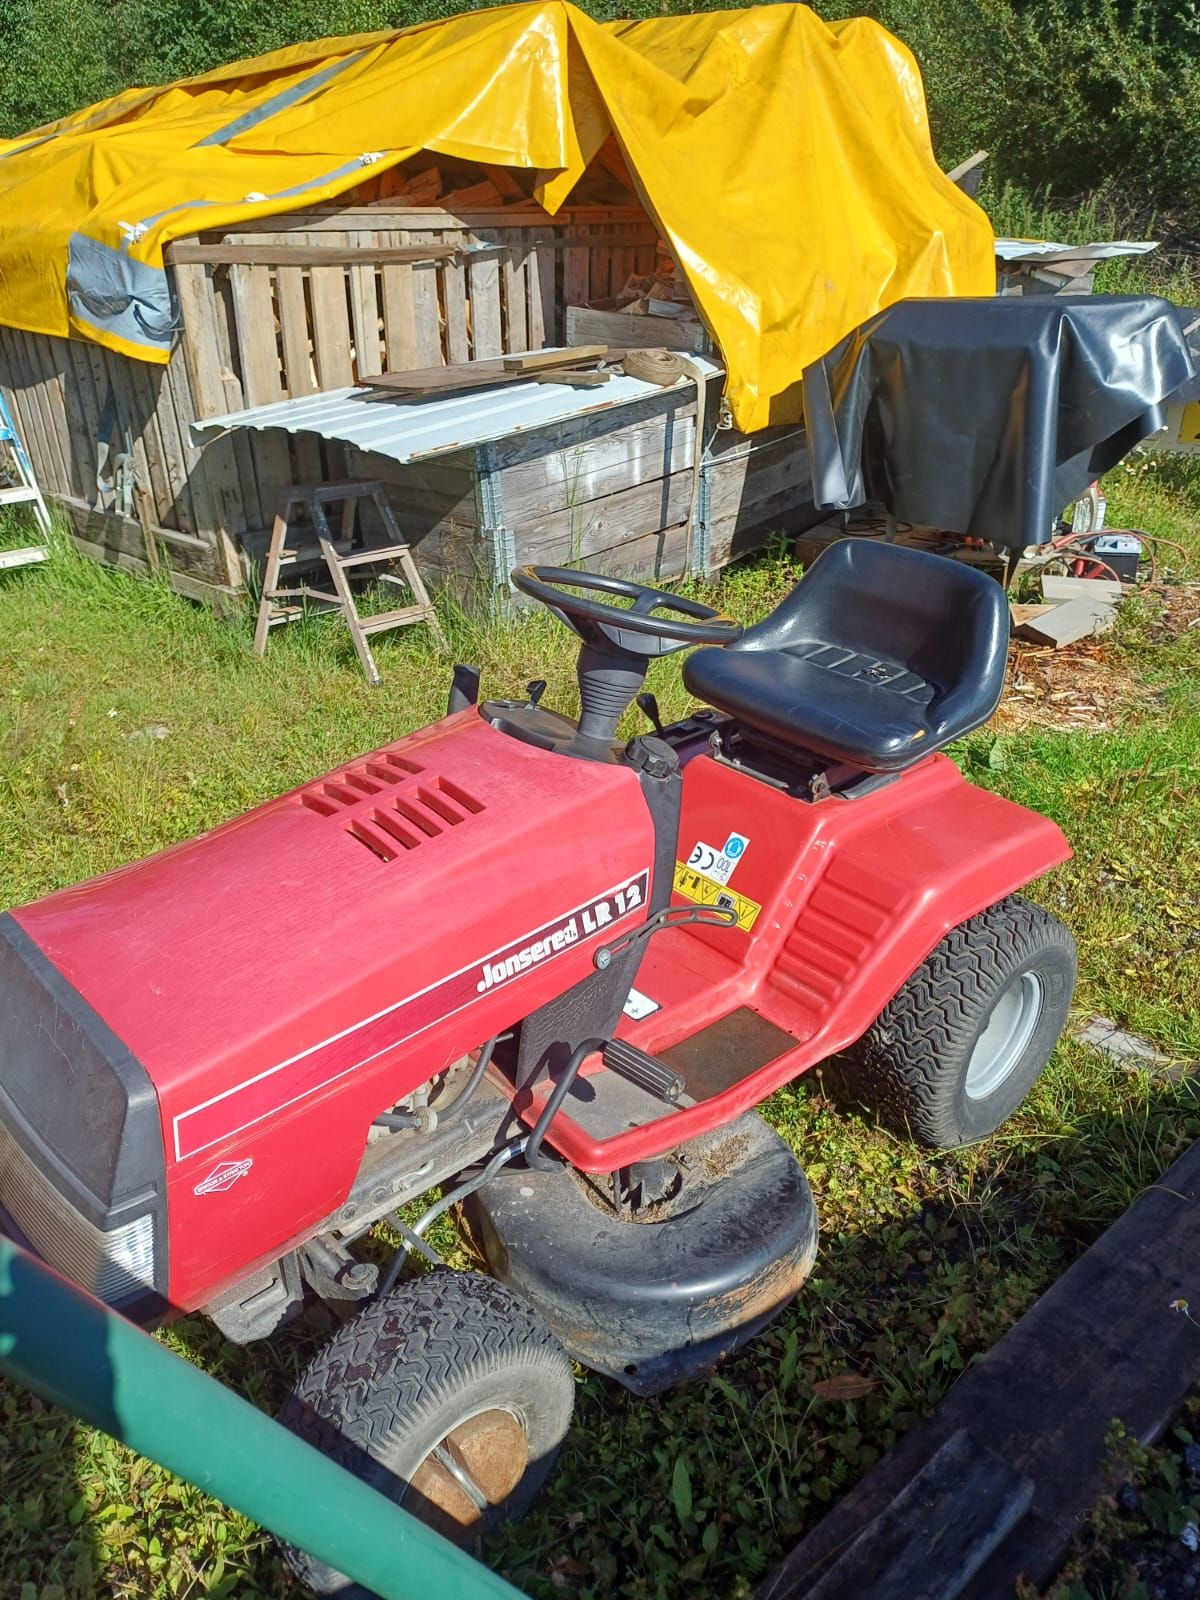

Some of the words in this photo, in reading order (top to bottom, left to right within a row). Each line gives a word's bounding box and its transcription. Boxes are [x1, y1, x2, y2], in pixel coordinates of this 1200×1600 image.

[476, 917, 579, 993] Jonsered
[581, 901, 613, 935] LR
[614, 884, 642, 915] 12
